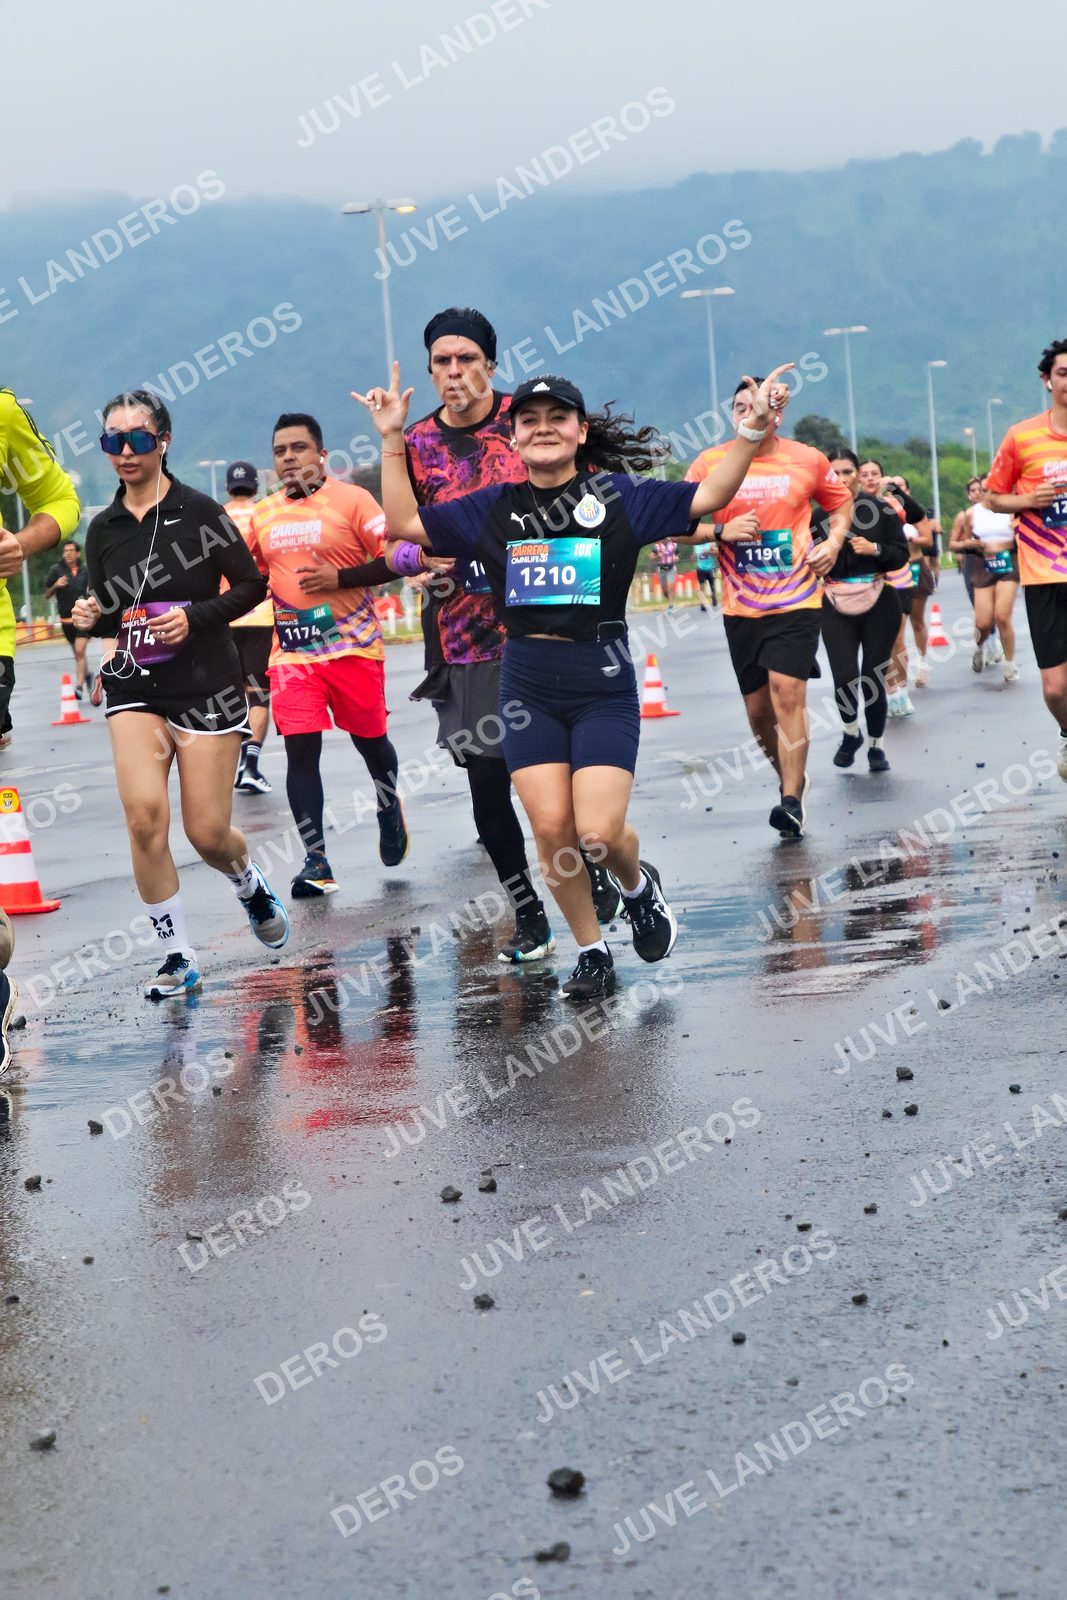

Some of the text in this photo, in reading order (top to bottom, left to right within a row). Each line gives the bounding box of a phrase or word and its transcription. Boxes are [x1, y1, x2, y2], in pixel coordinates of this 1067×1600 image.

[511, 544, 549, 557] CARRERA
[574, 543, 592, 557] 10K
[745, 547, 781, 561] 1191
[520, 565, 577, 586] 1210
[313, 607, 326, 619] 10K
[132, 628, 166, 648] 74
[285, 625, 321, 641] 1174
